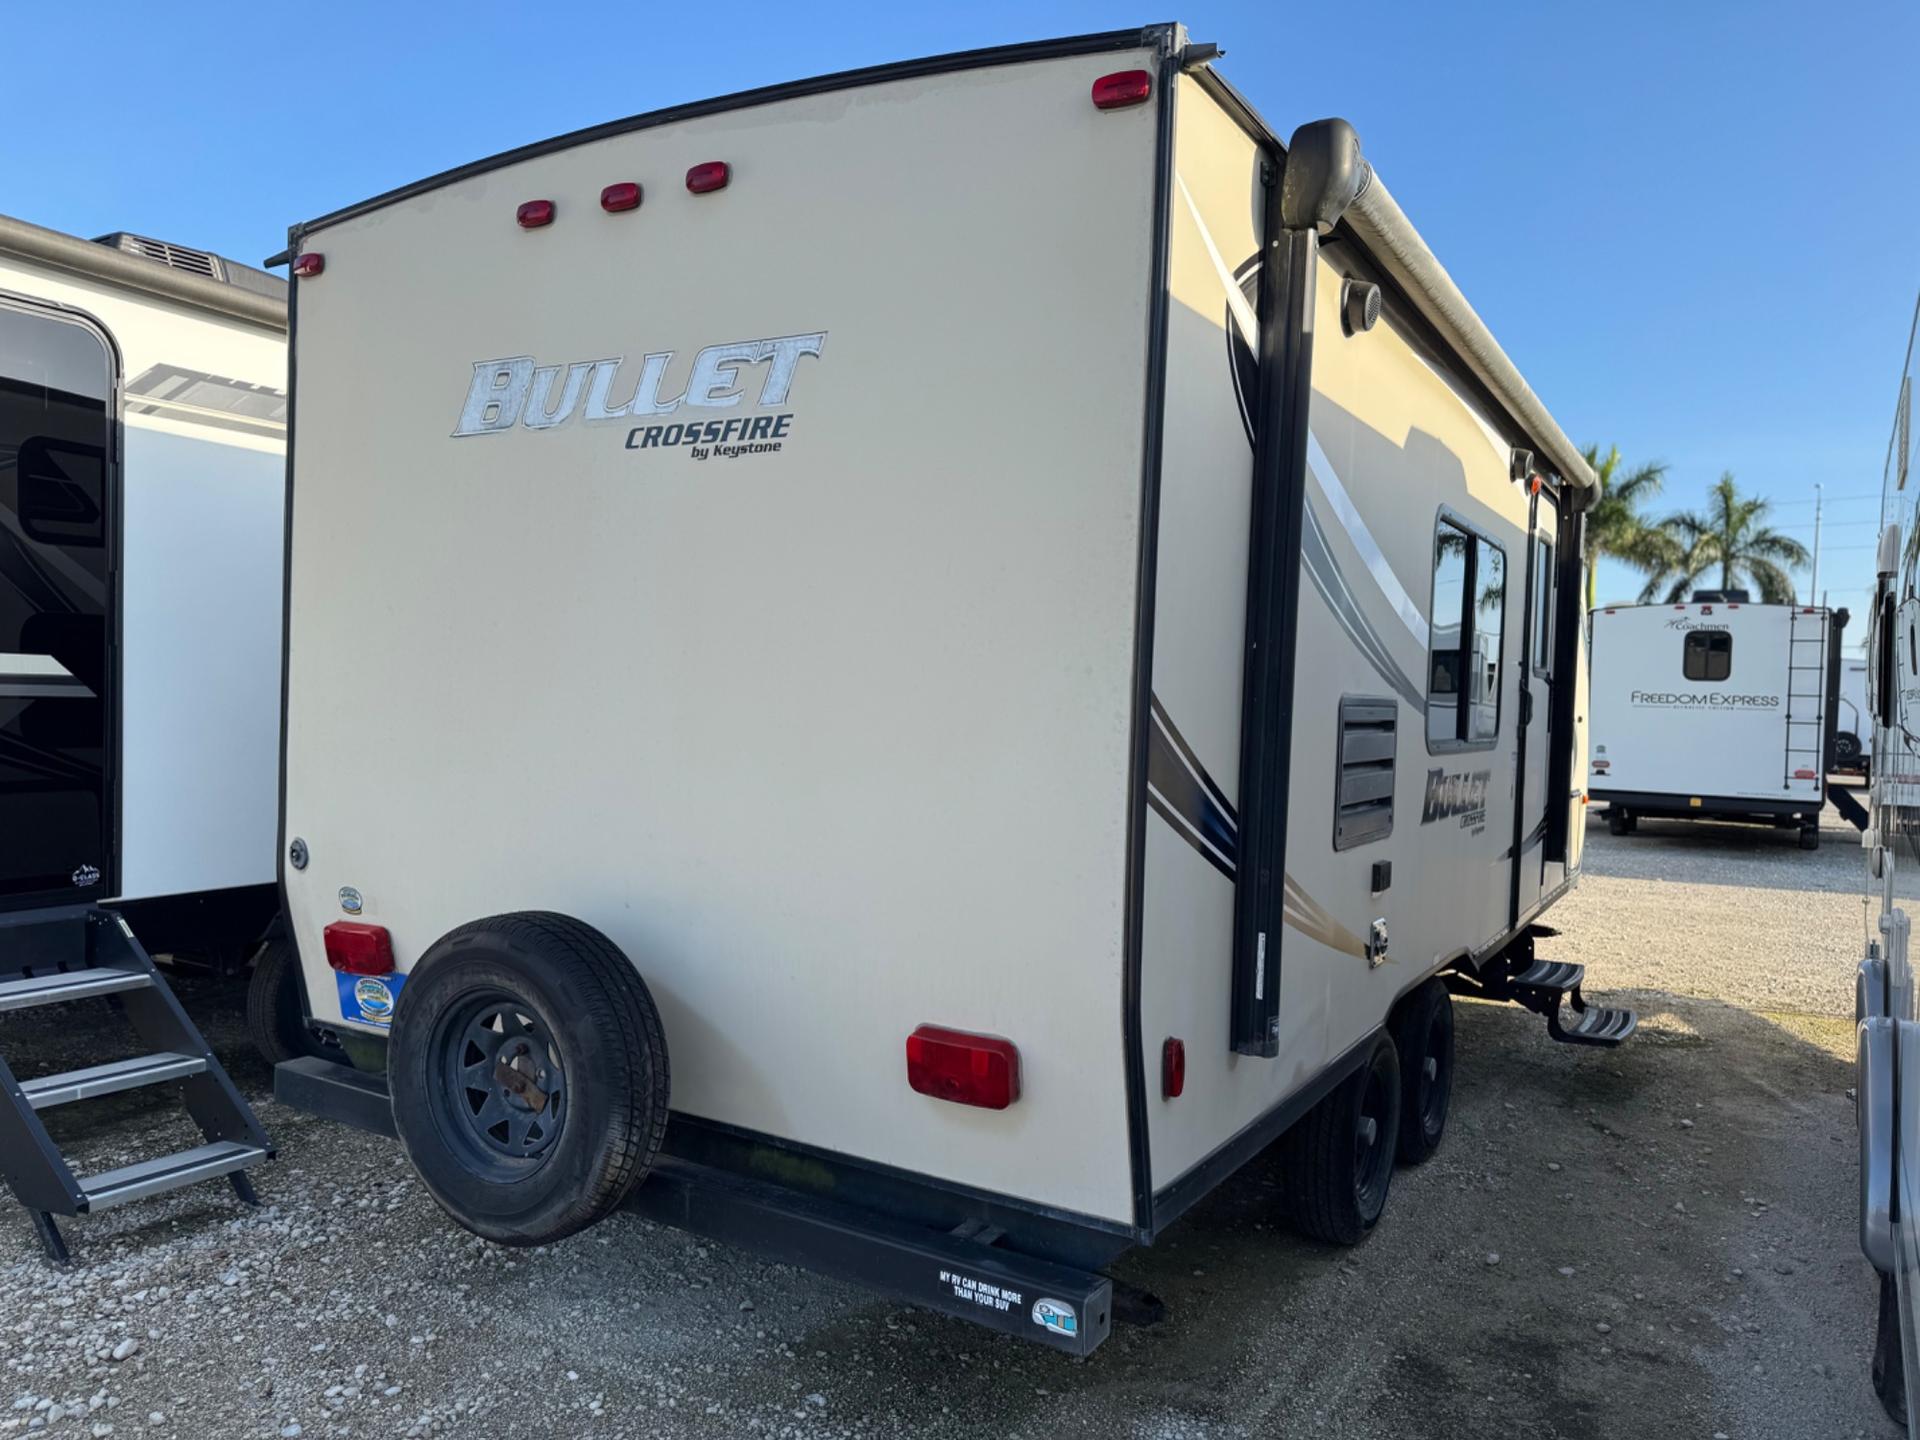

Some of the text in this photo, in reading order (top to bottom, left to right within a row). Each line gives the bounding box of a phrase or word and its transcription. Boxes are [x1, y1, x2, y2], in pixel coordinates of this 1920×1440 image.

[625, 414, 793, 449] CROSSFIRE
[691, 442, 781, 460] by Keystone
[1675, 621, 1729, 631] Coachmen
[1631, 690, 1779, 707] FREEDOM EXPRESS
[940, 1271, 1022, 1305] MY RV CAN DRINK MORE
[954, 1286, 1010, 1312] THAN YOUR SUV
